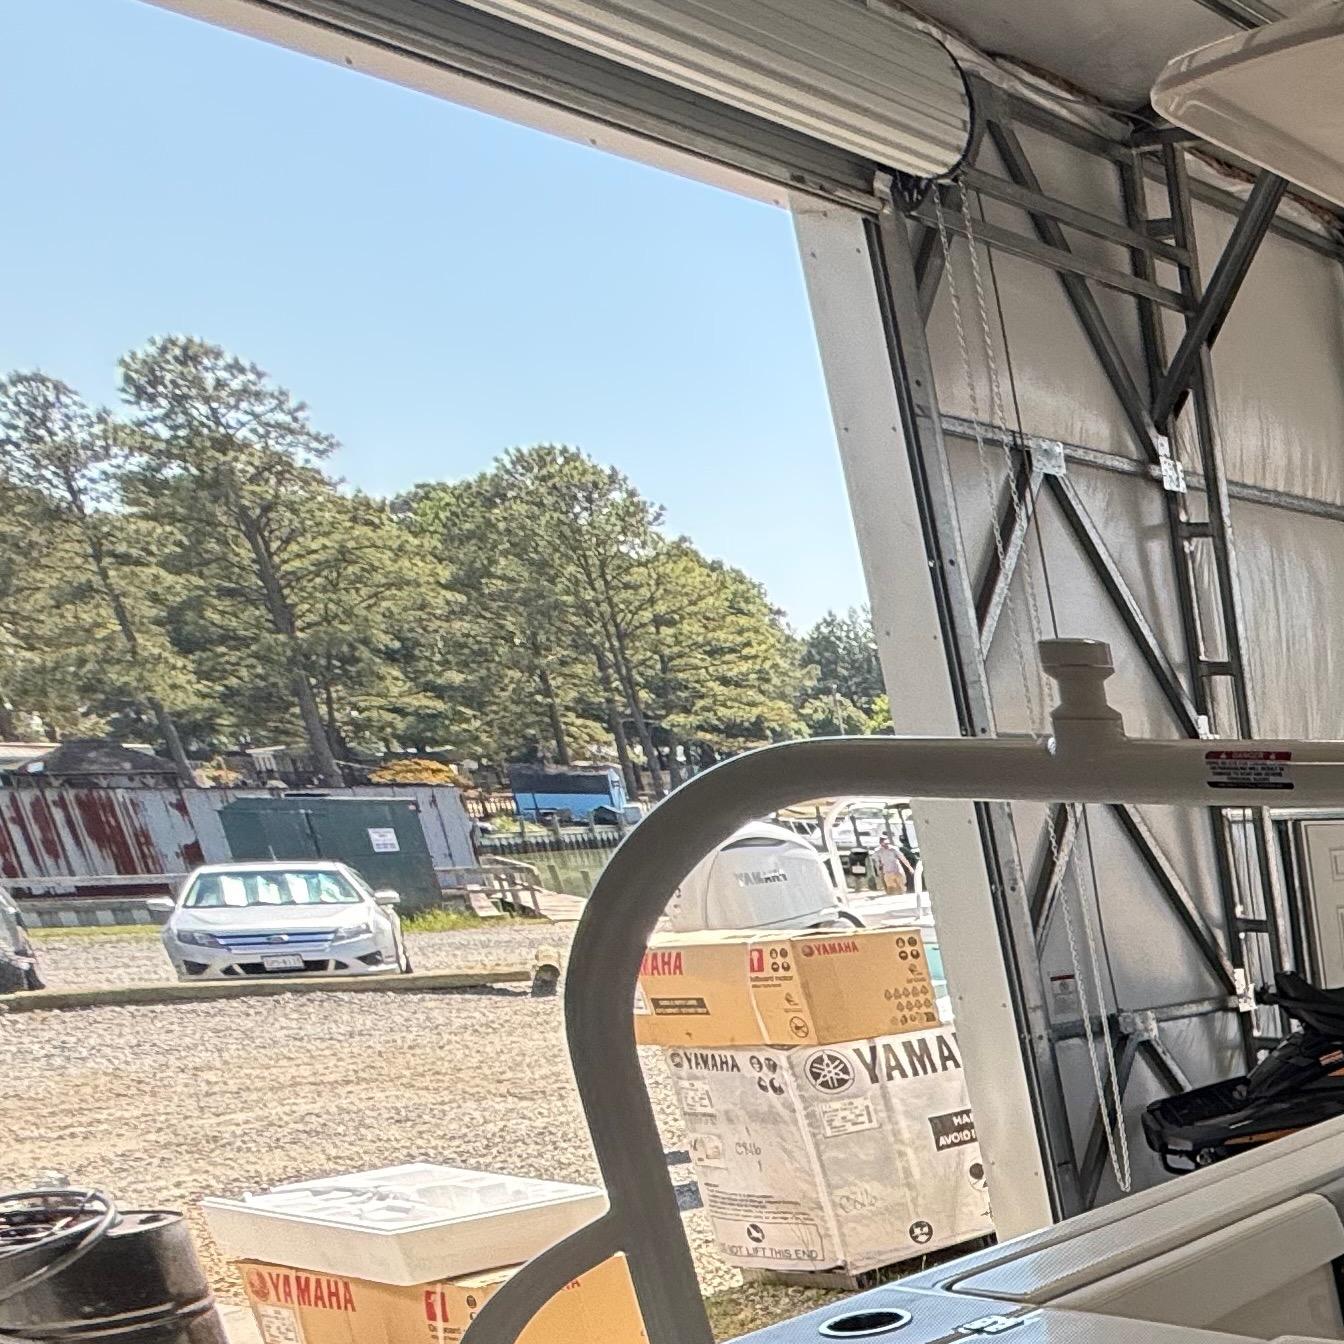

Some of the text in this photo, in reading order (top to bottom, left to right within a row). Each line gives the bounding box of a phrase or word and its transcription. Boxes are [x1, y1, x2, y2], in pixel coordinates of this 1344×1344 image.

[813, 941, 860, 956] YAMAHA
[640, 951, 684, 976] AHA
[683, 1051, 741, 1072] YAMAHA
[852, 1033, 962, 1085] YAMA
[745, 1247, 769, 1257] LIFT
[769, 1247, 792, 1259] THIS
[794, 1249, 819, 1260] END
[268, 1271, 357, 1312] YAMAHA
